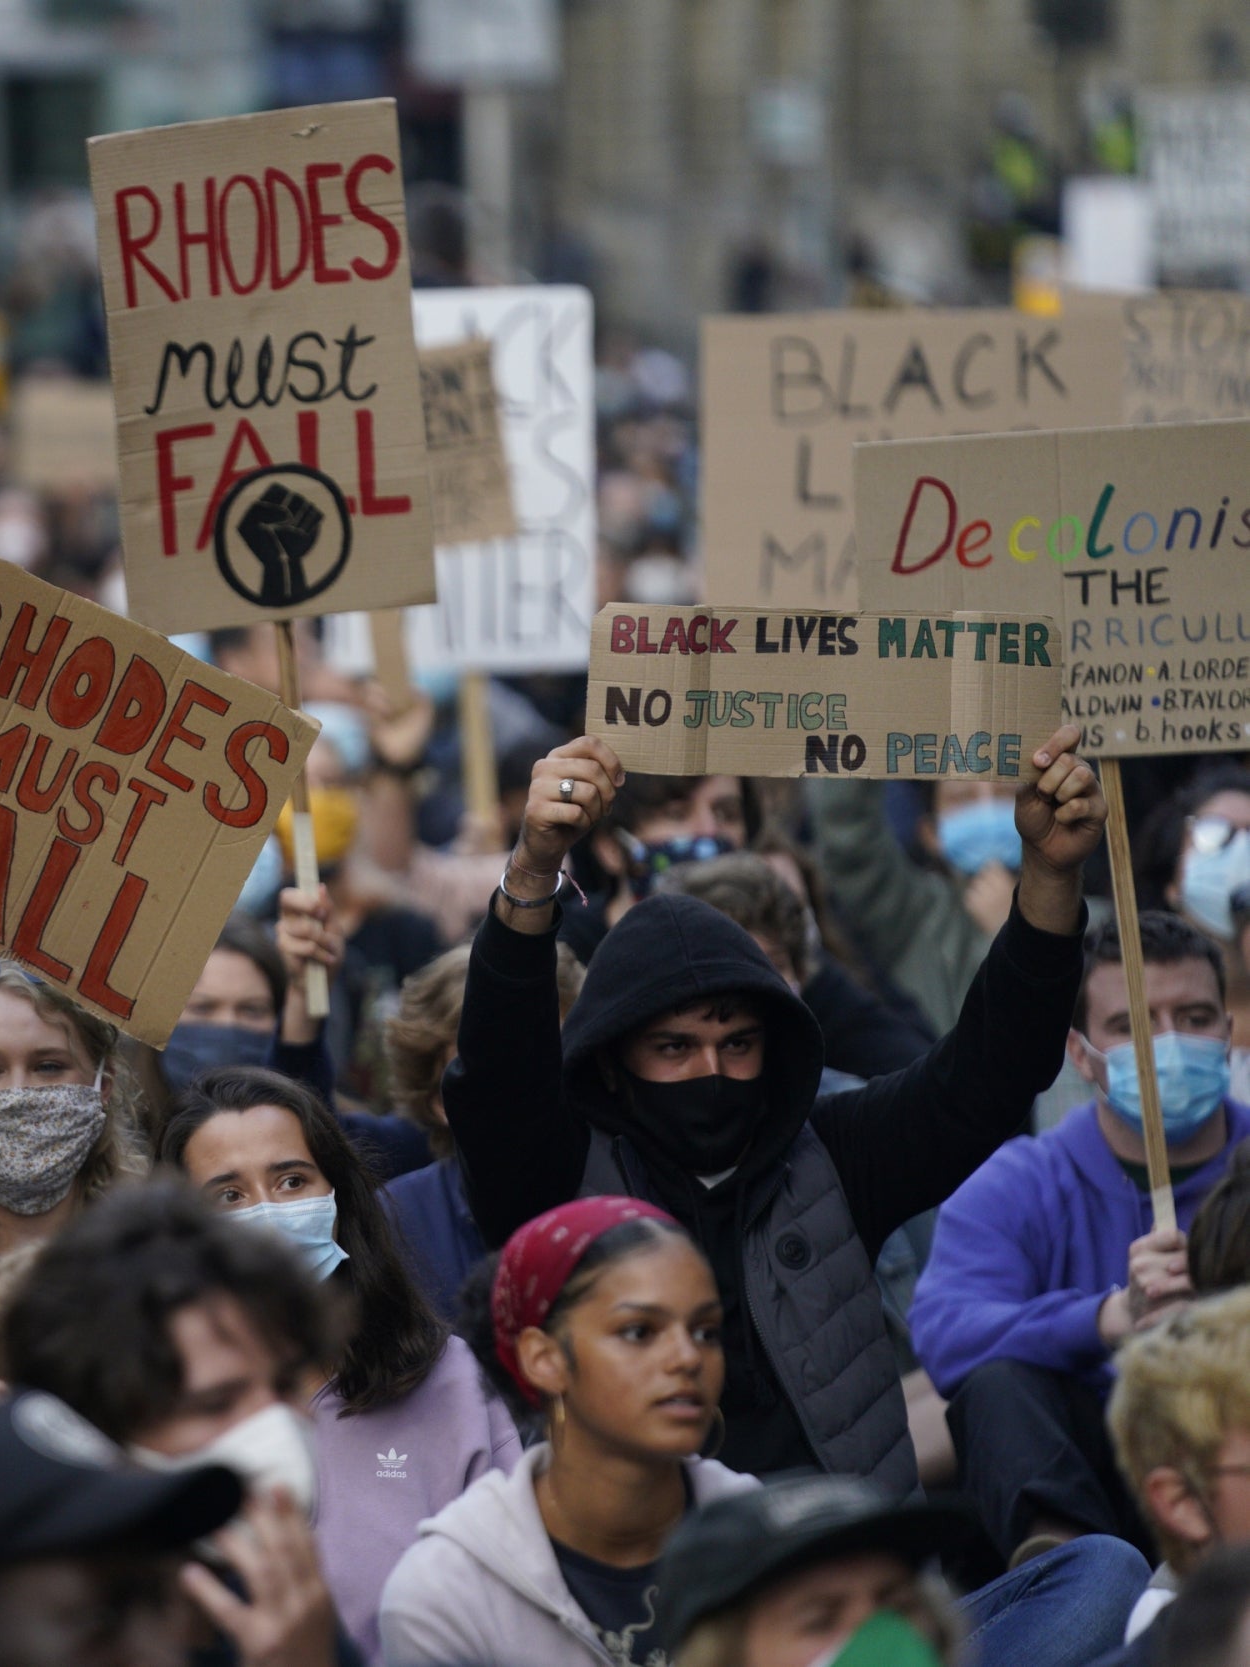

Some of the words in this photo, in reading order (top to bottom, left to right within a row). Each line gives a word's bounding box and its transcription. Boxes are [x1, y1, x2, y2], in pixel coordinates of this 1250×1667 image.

[114, 153, 402, 309] RHODES
[144, 323, 378, 416] must
[770, 327, 1068, 427] BLACK
[1064, 566, 1171, 606] THE
[610, 614, 739, 655] BLACK
[754, 615, 859, 656] LIVES
[877, 617, 1052, 667] MATTER
[1180, 656, 1250, 681] LORDE
[604, 686, 673, 727] NO
[682, 689, 849, 731] JUSTICE
[1161, 716, 1241, 743] hooks
[804, 734, 867, 774] NO
[886, 731, 1022, 777] PEACE
[375, 1469, 407, 1478] adidas
